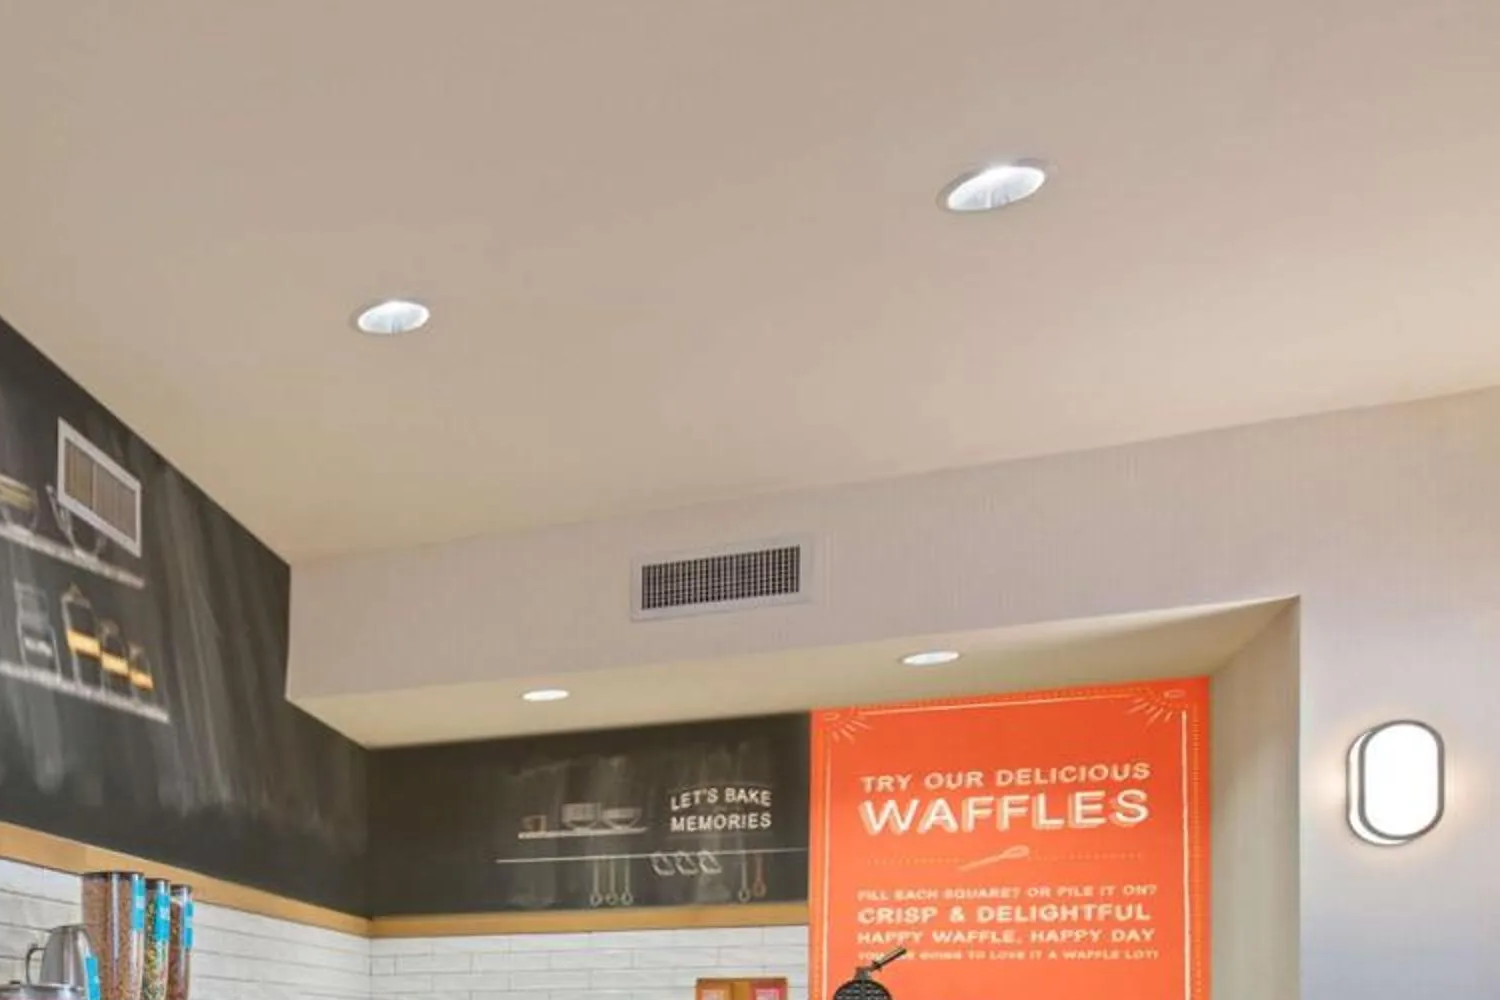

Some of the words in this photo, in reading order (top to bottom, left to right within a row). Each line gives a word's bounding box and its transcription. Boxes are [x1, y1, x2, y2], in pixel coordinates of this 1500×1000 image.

[860, 774, 912, 793] TRY
[924, 771, 984, 790] OUR
[995, 762, 1151, 787] DELICIOUS
[670, 787, 719, 811] LET'S
[724, 787, 772, 807] BAKE
[670, 812, 772, 832] MEMORIES
[858, 789, 1149, 835] WAFFLES
[1028, 886, 1050, 898] OR
[1057, 885, 1094, 897] PILE
[1101, 885, 1116, 896] IT
[857, 905, 938, 925] CRISP
[949, 905, 965, 923] &
[976, 903, 1152, 923] DELIGHTFUL
[856, 930, 923, 944] HAPPY
[1030, 928, 1103, 943] HAPPY
[1111, 928, 1155, 943] DAY
